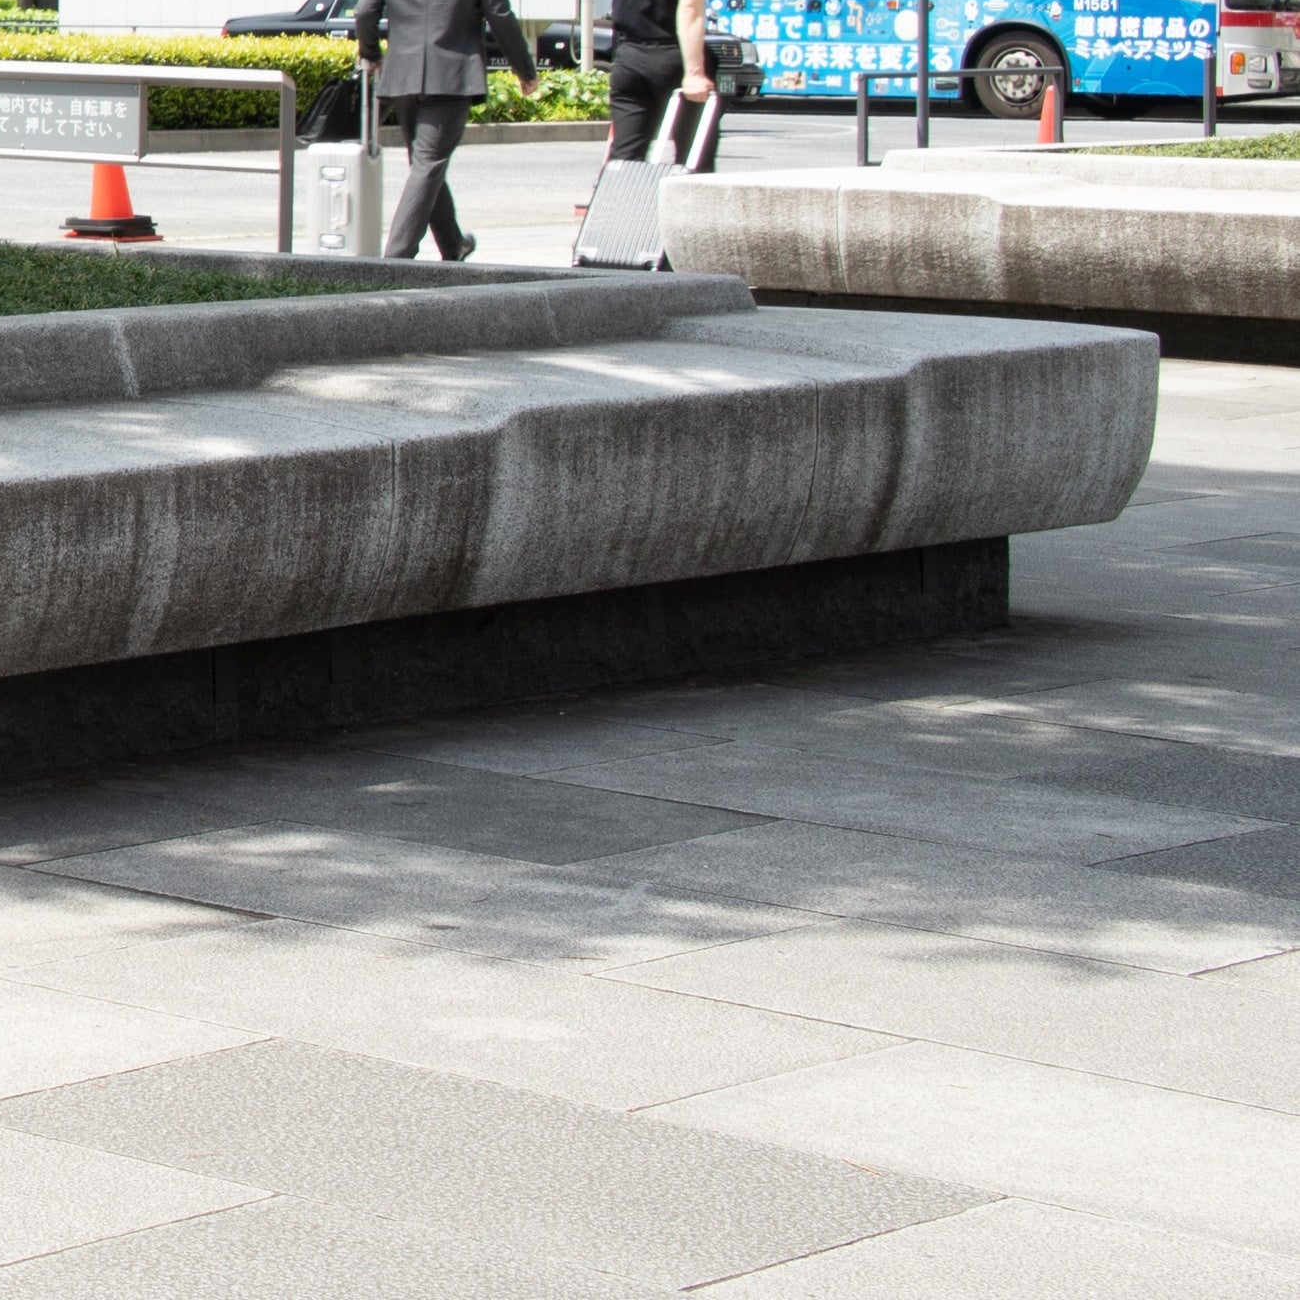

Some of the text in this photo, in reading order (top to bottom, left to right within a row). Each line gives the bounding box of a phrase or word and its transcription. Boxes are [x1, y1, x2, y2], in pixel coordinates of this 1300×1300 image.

[1074, 16, 1210, 38] 超精密部品の
